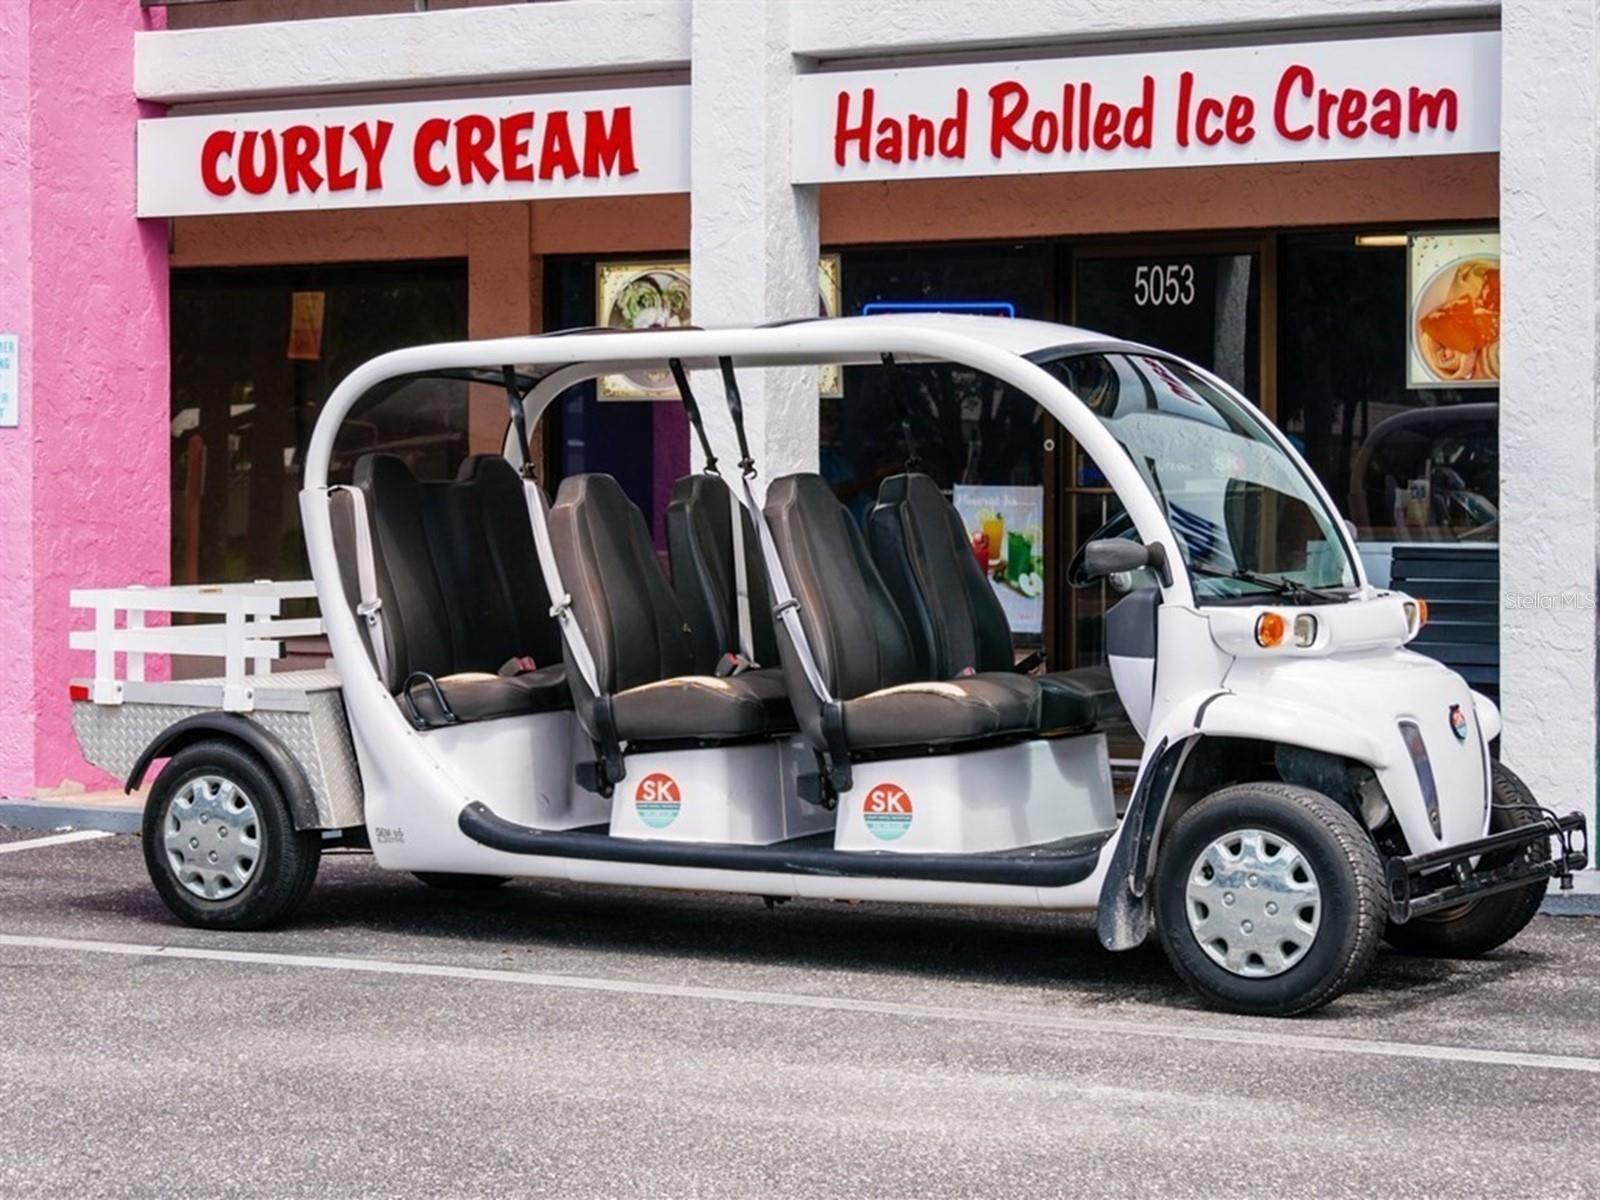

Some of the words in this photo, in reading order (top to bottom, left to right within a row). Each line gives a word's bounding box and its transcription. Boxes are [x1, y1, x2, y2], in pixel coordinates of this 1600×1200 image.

[835, 87, 968, 167] Hand
[988, 75, 1154, 158] Rolled
[1176, 70, 1256, 147] Ice
[1274, 64, 1459, 141] Cream
[200, 119, 394, 198] CURLY
[412, 105, 639, 188] CREAM
[1134, 264, 1195, 306] 5053
[642, 780, 673, 801] SK
[871, 790, 904, 813] SK
